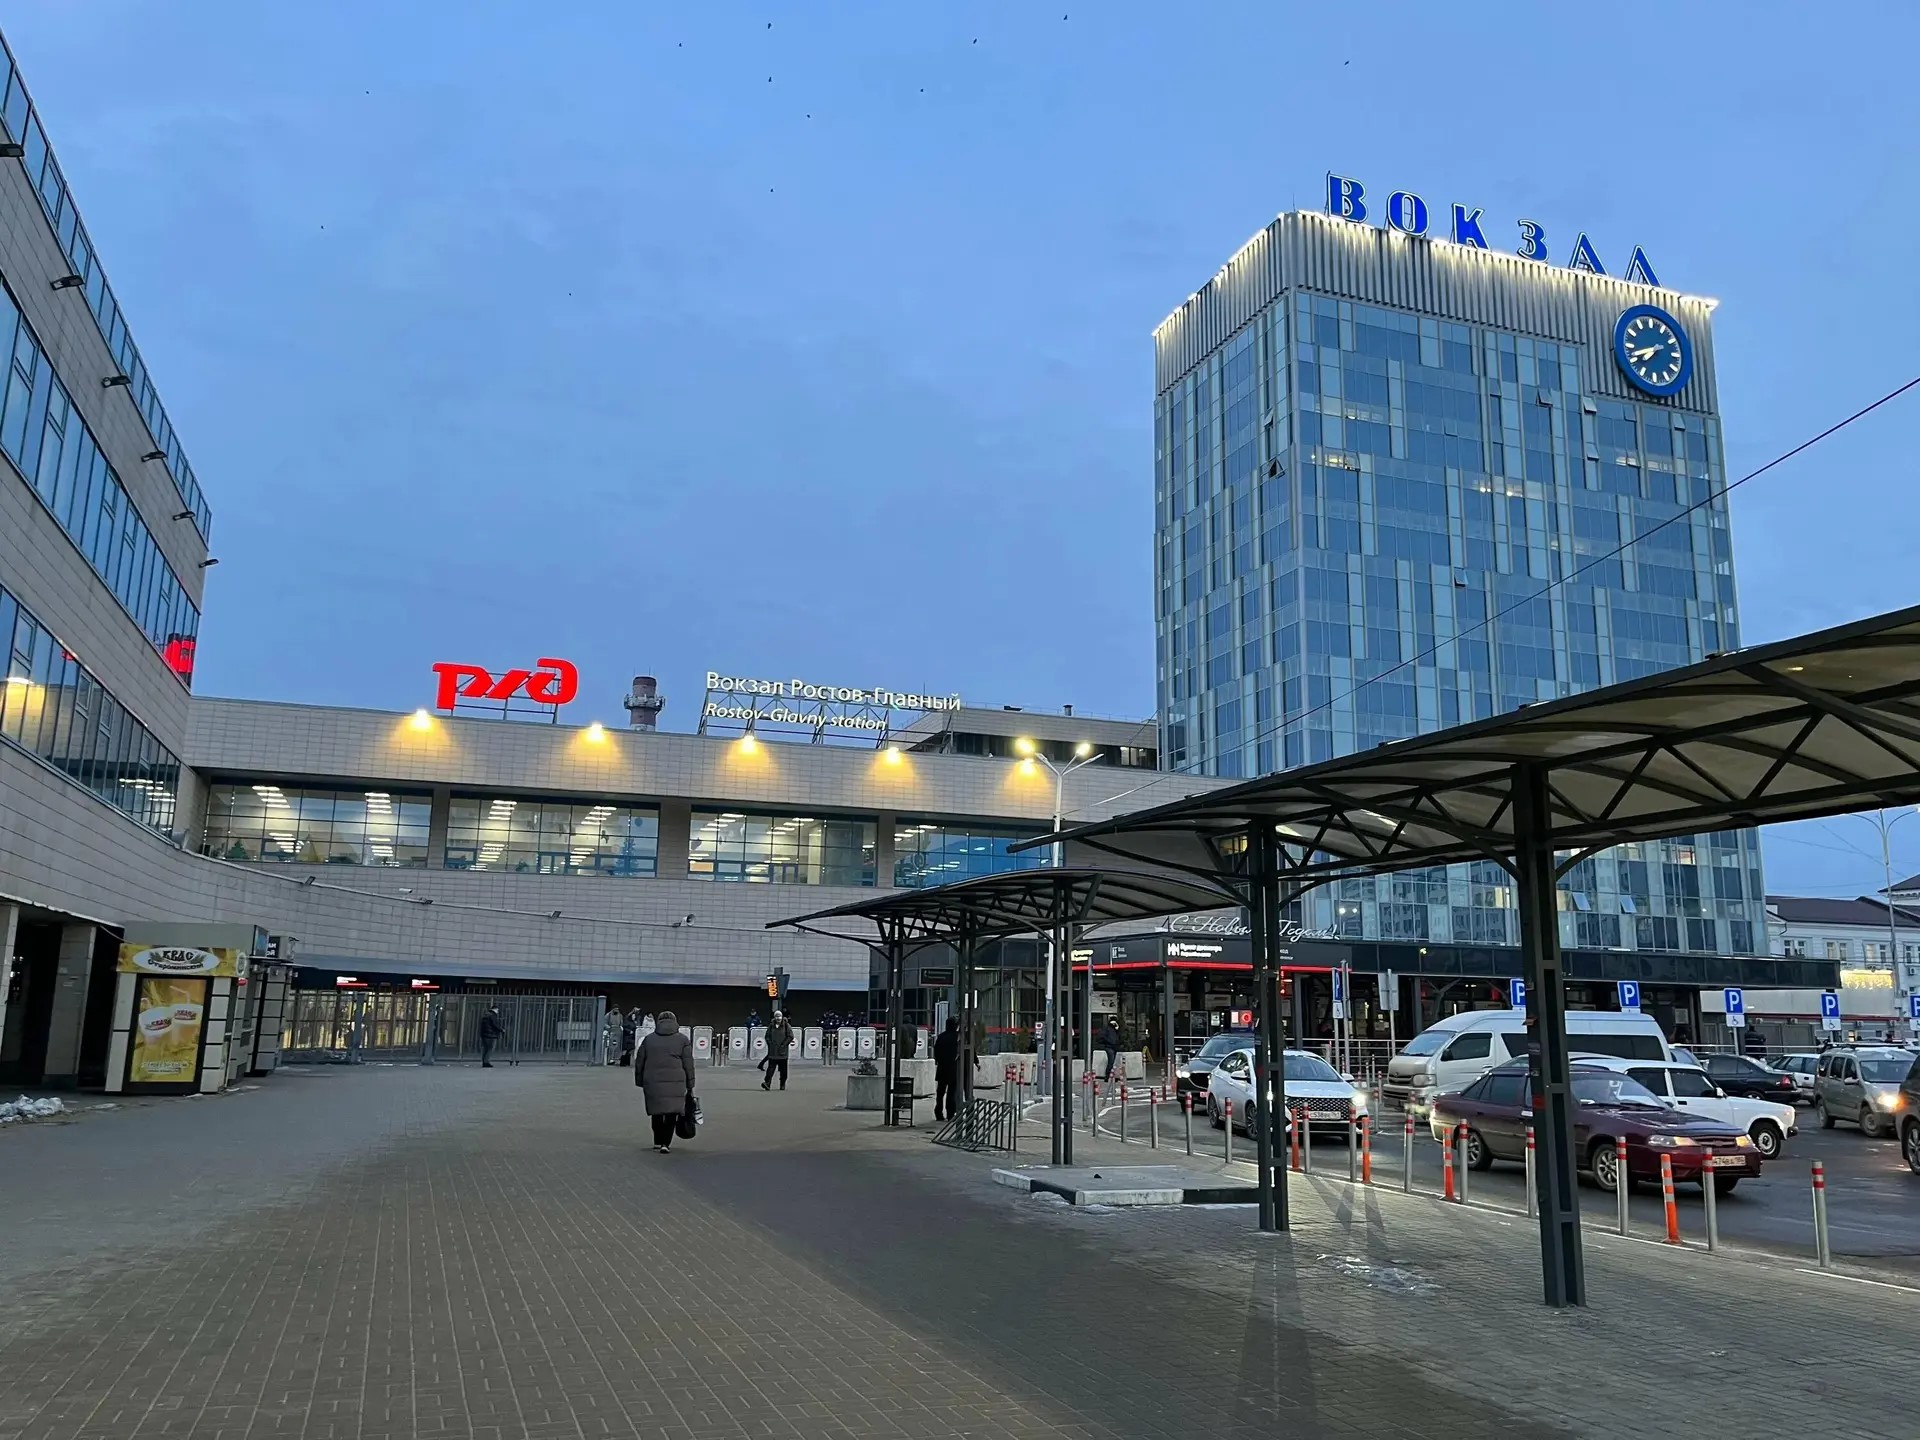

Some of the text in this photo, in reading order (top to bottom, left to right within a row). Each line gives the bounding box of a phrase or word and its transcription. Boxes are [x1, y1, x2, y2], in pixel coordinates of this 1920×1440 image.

[1327, 172, 1662, 287] ВОКЗАЛ
[706, 671, 962, 711] Вокзал Ростов-Главный
[704, 702, 887, 731] Rostov-Glavny station
